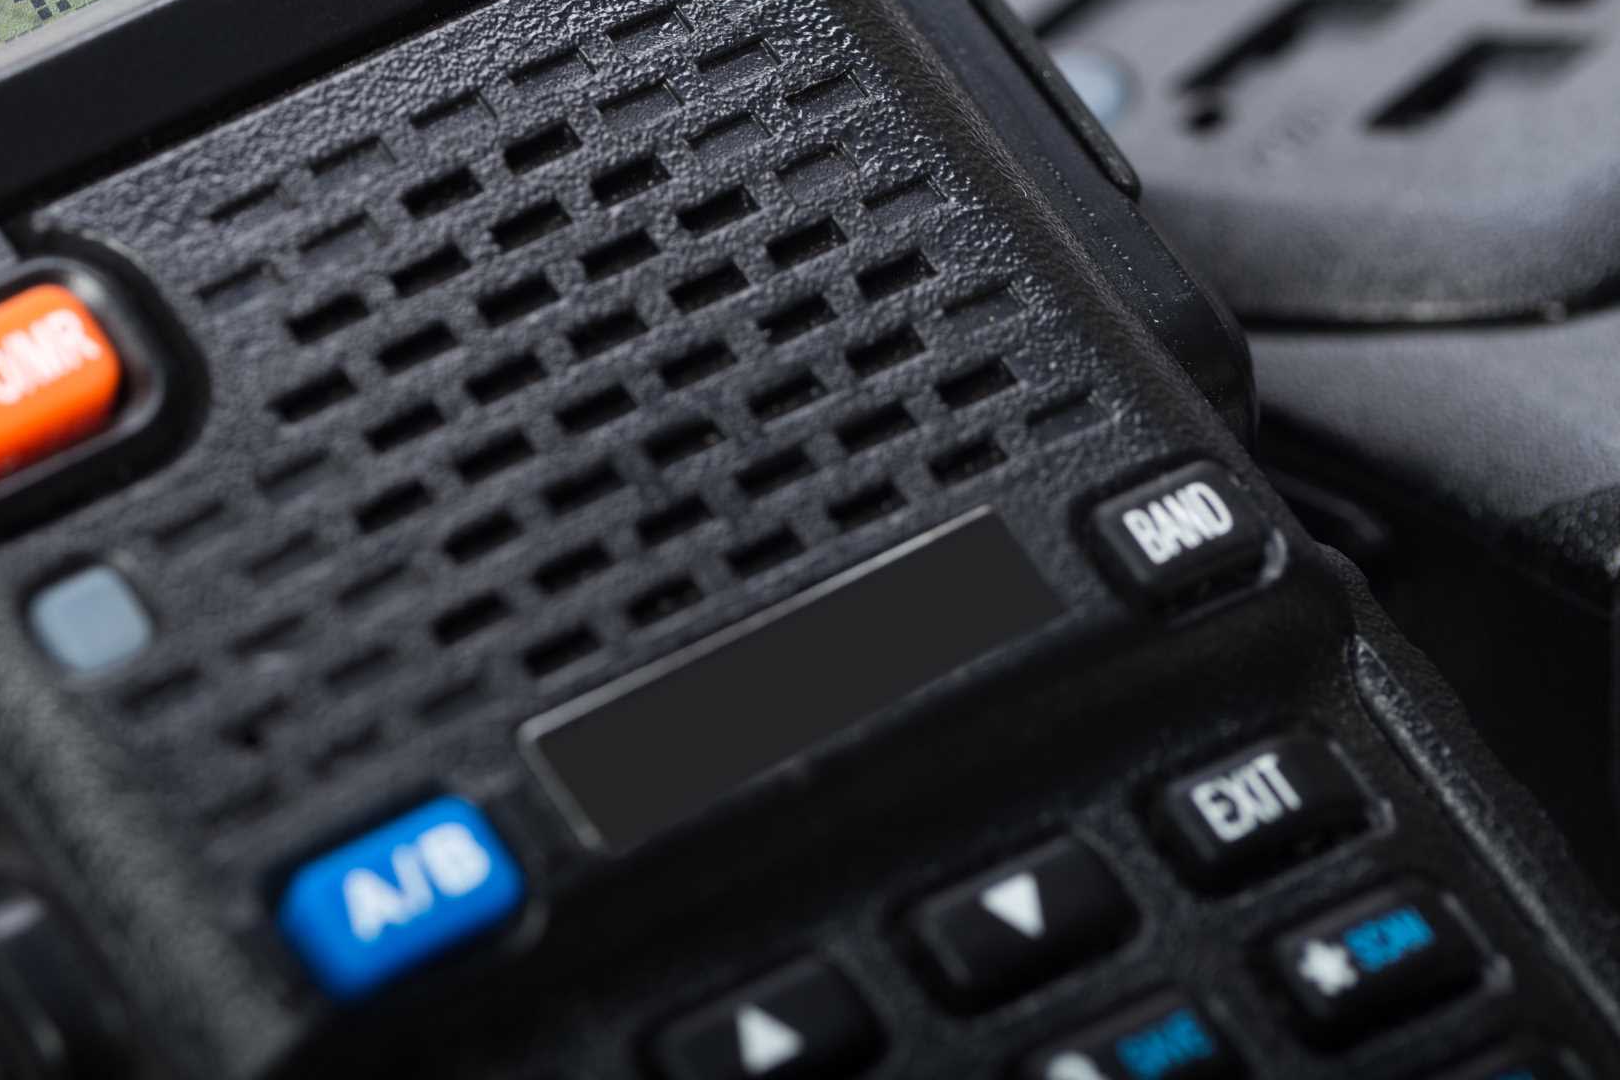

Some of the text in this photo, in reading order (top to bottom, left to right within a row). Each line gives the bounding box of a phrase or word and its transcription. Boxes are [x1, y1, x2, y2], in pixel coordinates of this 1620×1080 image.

[1122, 481, 1234, 566] BAND
[1191, 753, 1303, 843] EXIT
[343, 821, 492, 943] A/B
